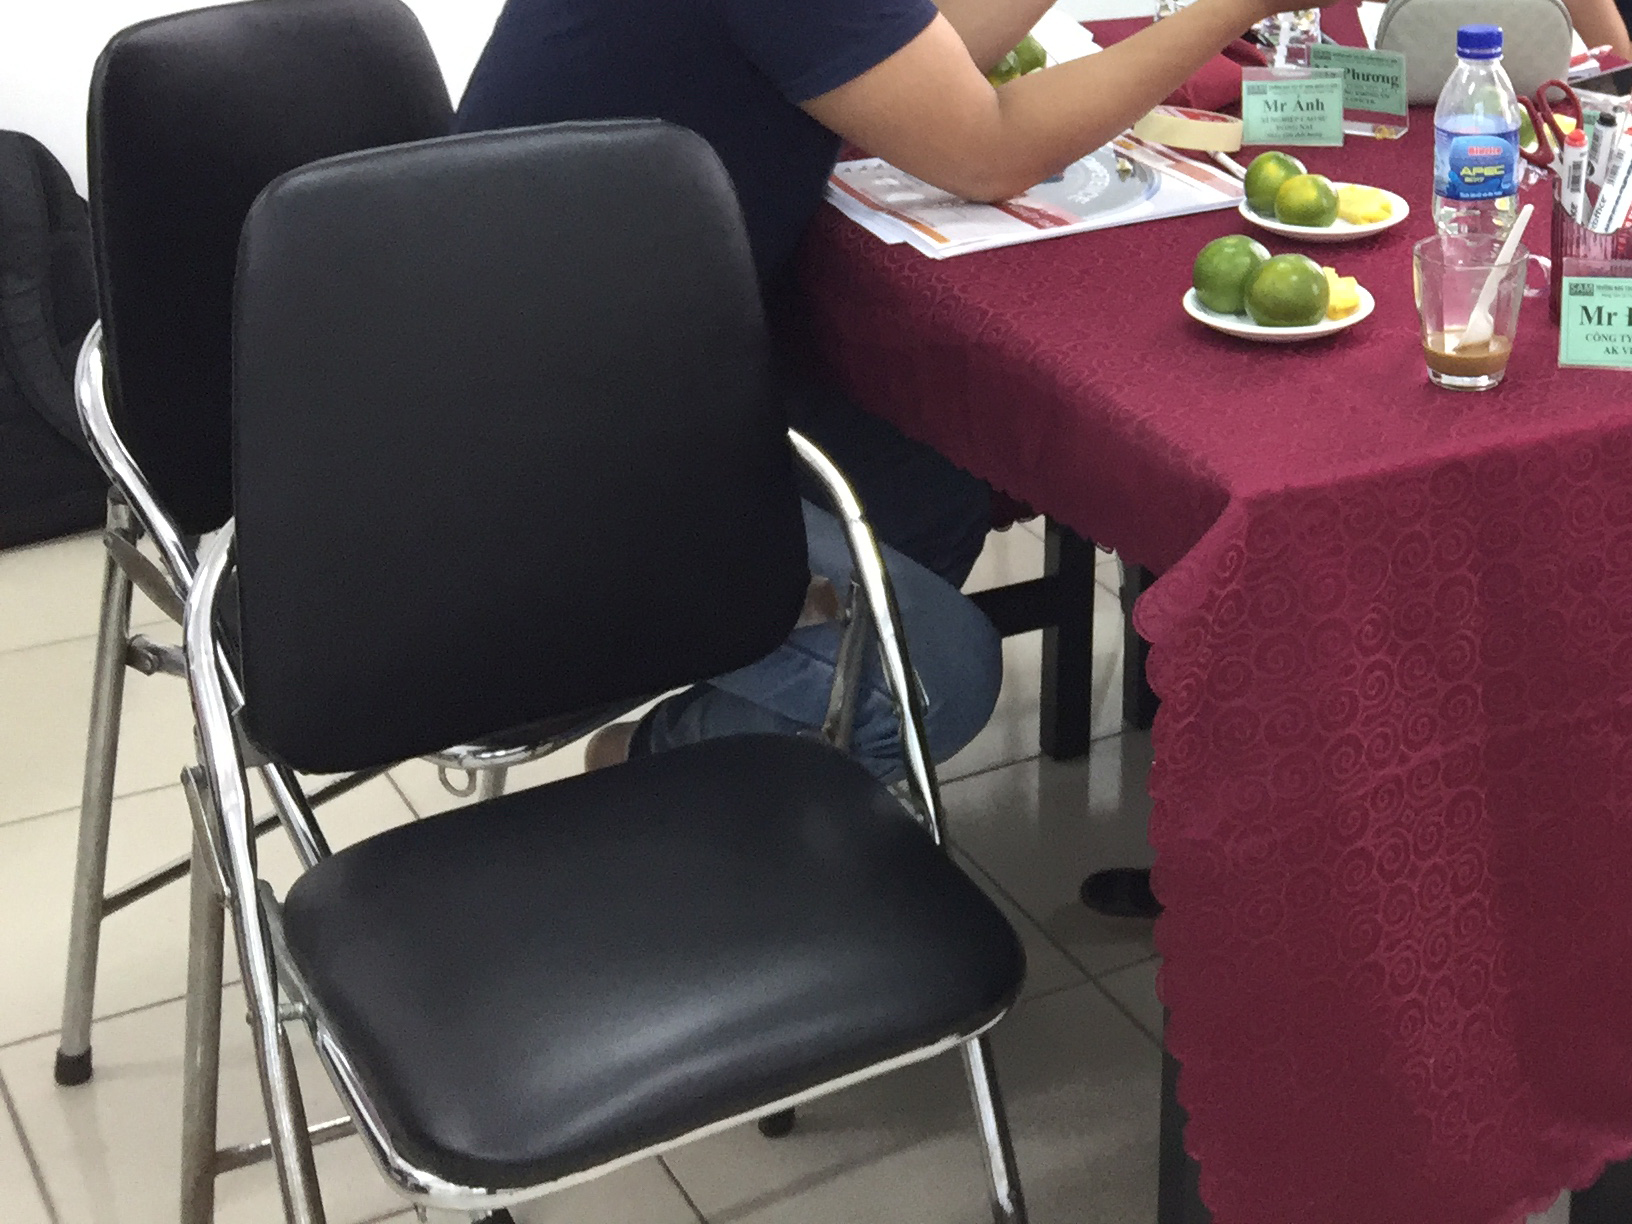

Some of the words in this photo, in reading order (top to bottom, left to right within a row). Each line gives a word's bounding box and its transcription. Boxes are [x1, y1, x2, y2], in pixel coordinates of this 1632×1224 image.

[1263, 99, 1287, 113] Mr
[1460, 164, 1506, 177] APEC
[1579, 305, 1618, 326] Mr
[1585, 331, 1617, 342] CÔNG
[1621, 333, 1632, 343] TY
[1603, 346, 1618, 355] AK
